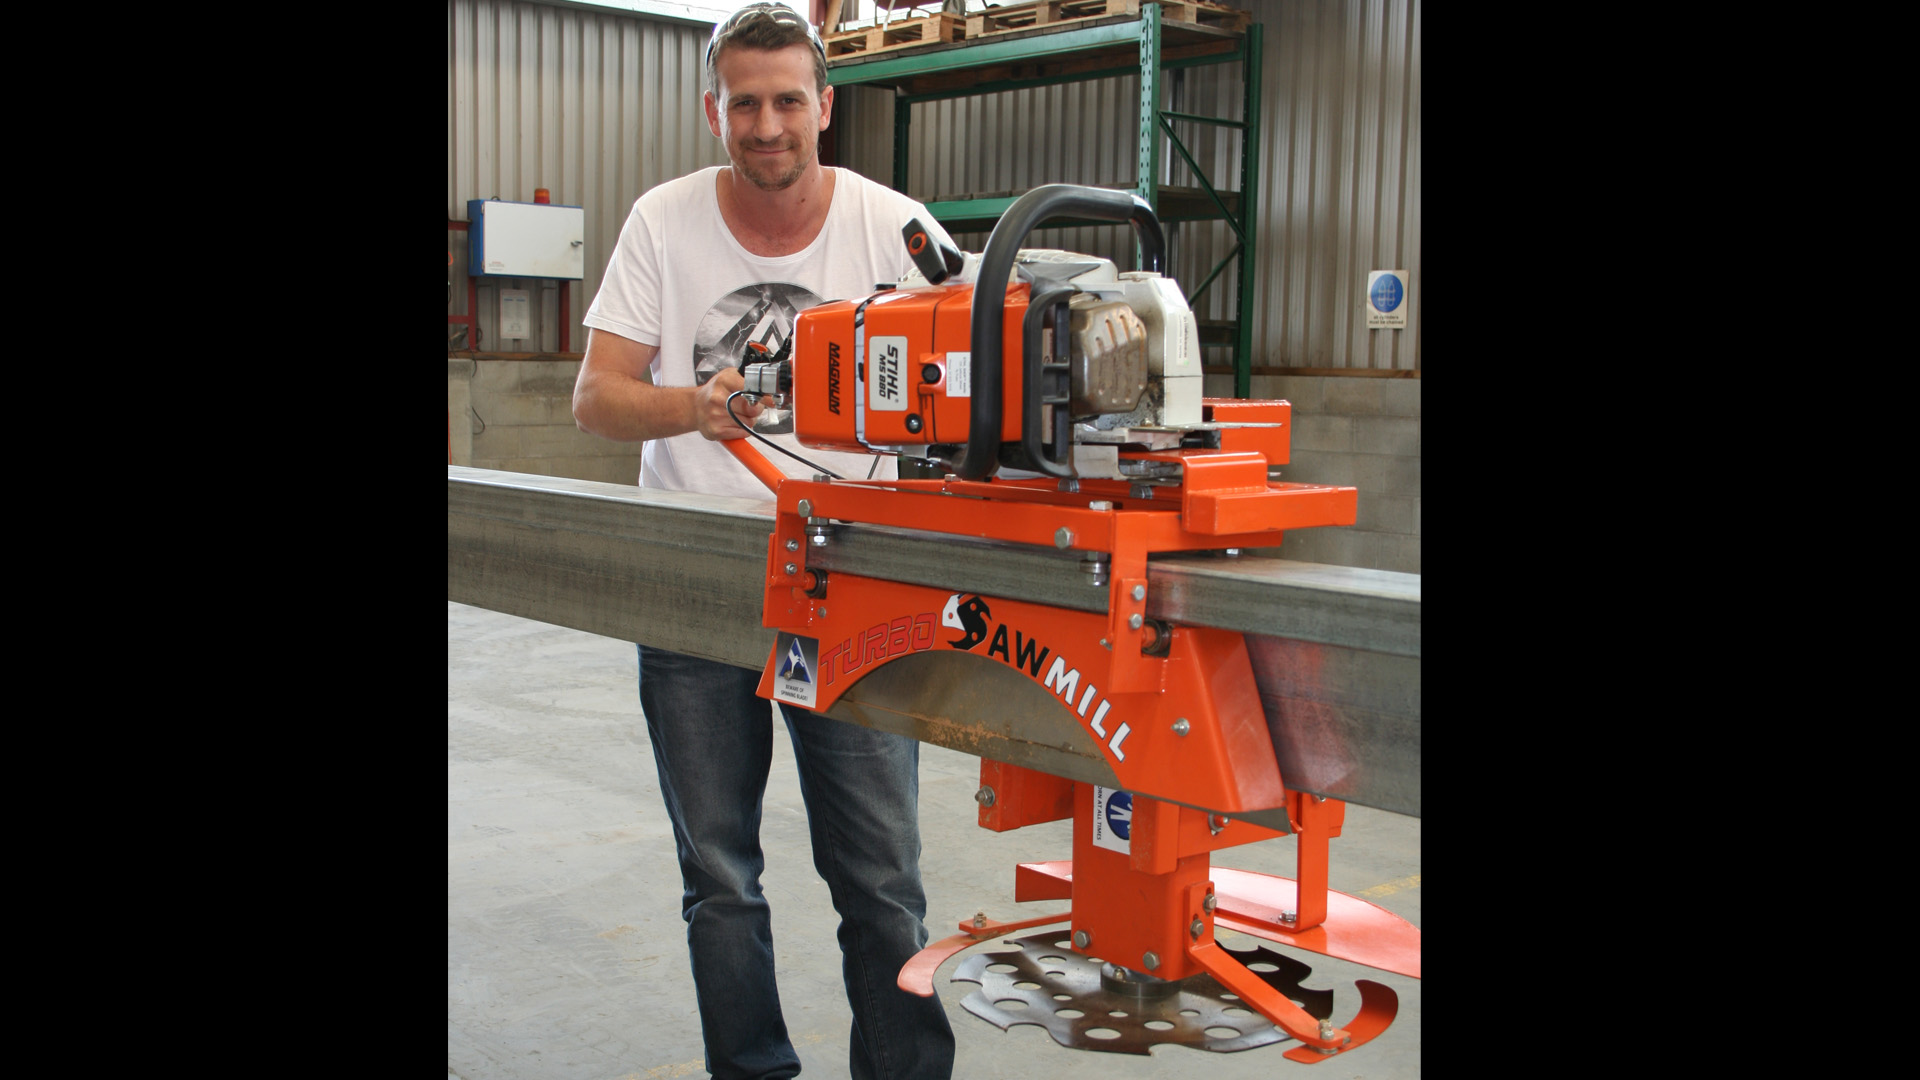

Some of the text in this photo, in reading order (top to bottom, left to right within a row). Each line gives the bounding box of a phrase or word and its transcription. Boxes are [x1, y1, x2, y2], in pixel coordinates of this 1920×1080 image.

[829, 342, 840, 415] MAGNUM
[879, 353, 886, 374] MS
[887, 344, 898, 400] STIHL
[819, 612, 938, 687] TURBO
[785, 684, 798, 692] BEWARE
[1097, 800, 1102, 808] AT
